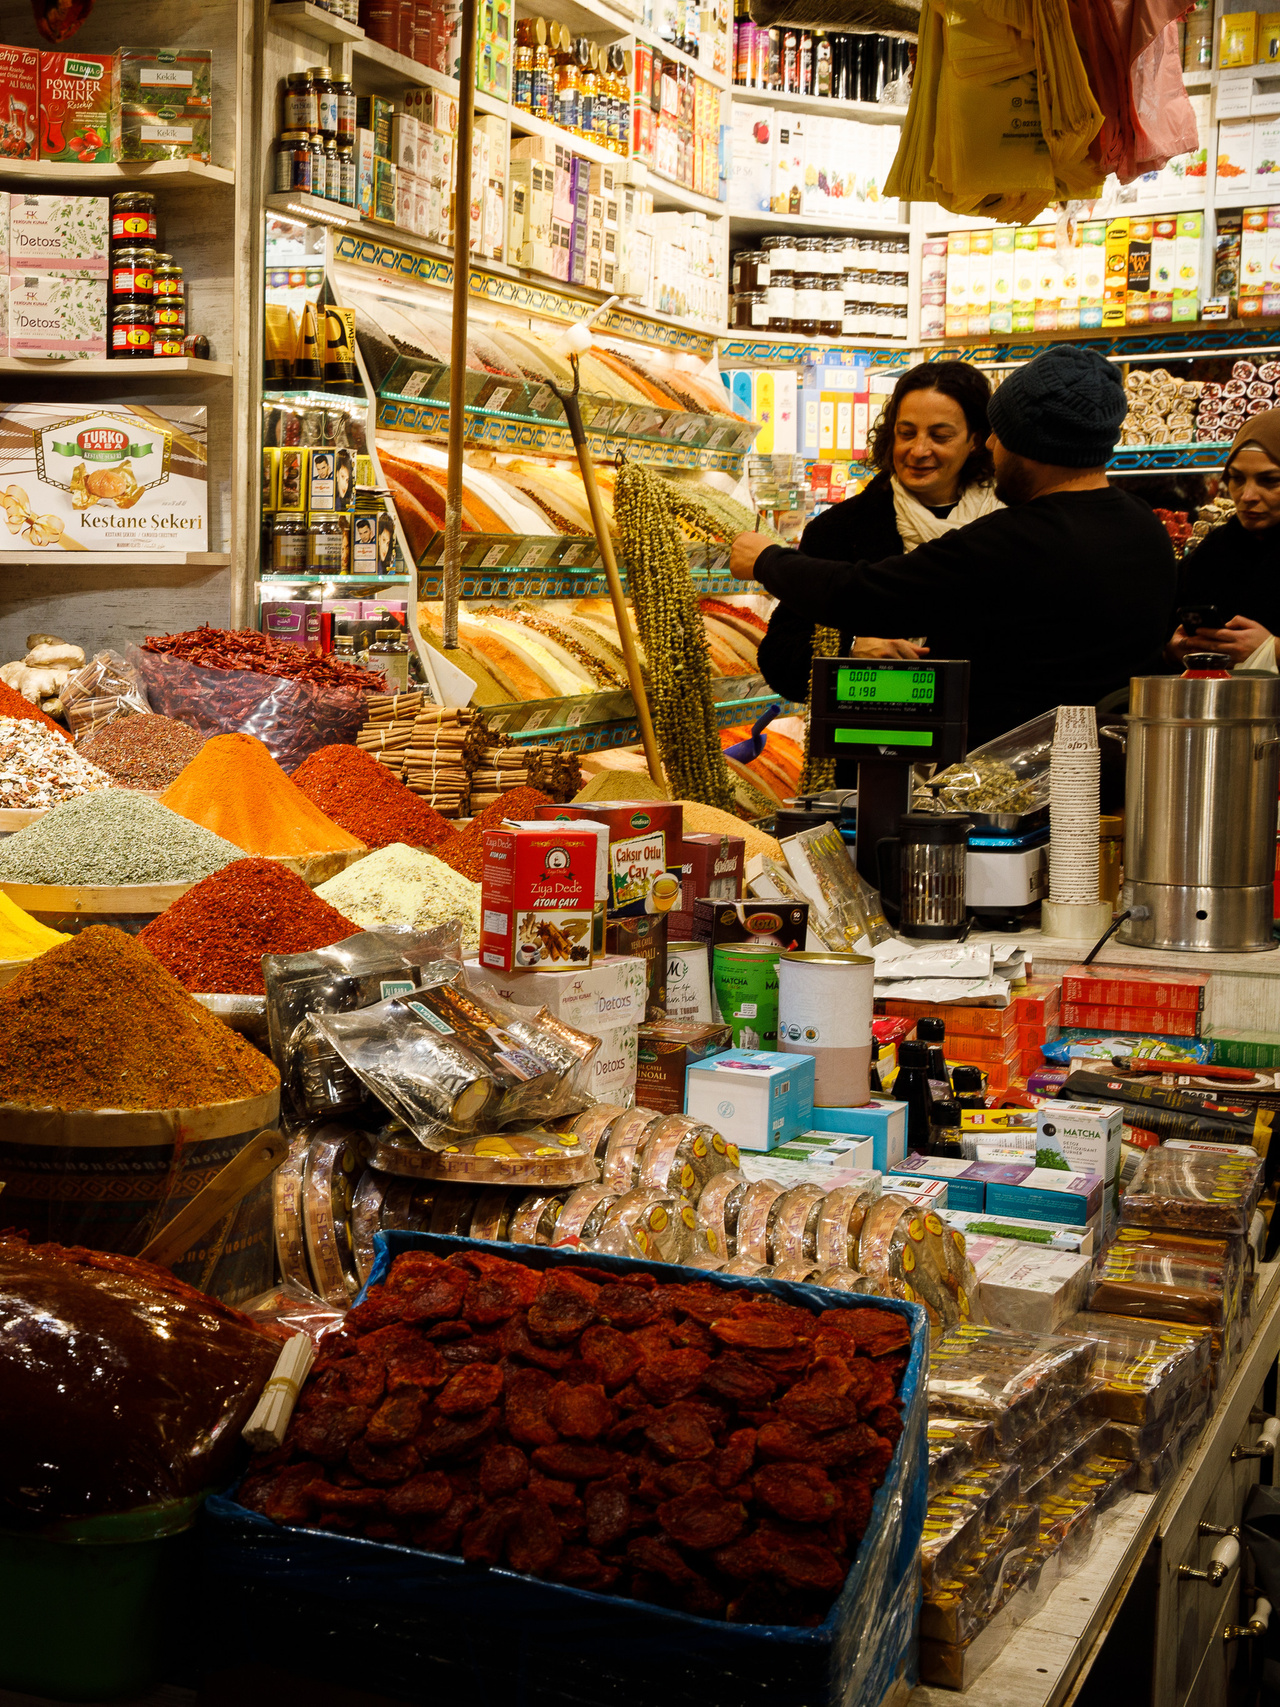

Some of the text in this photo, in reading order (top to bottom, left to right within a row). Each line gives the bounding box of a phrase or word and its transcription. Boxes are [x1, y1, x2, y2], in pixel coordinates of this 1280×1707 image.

[22, 52, 36, 65] Tea
[156, 72, 177, 81] Kekik
[46, 79, 101, 92] POWDER
[52, 89, 94, 101] DRINK
[156, 129, 177, 138] Kekik
[20, 234, 61, 248] Detoxs
[20, 314, 61, 329] Detoxs
[82, 430, 124, 444] TURKO
[80, 513, 202, 531] Kestane Şekeri
[616, 846, 661, 867] Çakşır Otlu
[628, 865, 648, 882] Çay
[530, 882, 553, 898] Ziya
[533, 898, 579, 909] ATOM ÇAYI
[750, 919, 777, 930] KOZA
[721, 978, 748, 986] MATCHA
[598, 994, 631, 1013] Detoxs
[595, 1057, 625, 1076] Detoxs
[1063, 1128, 1101, 1139] MATCHA
[437, 1161, 553, 1177] SET SPICE
